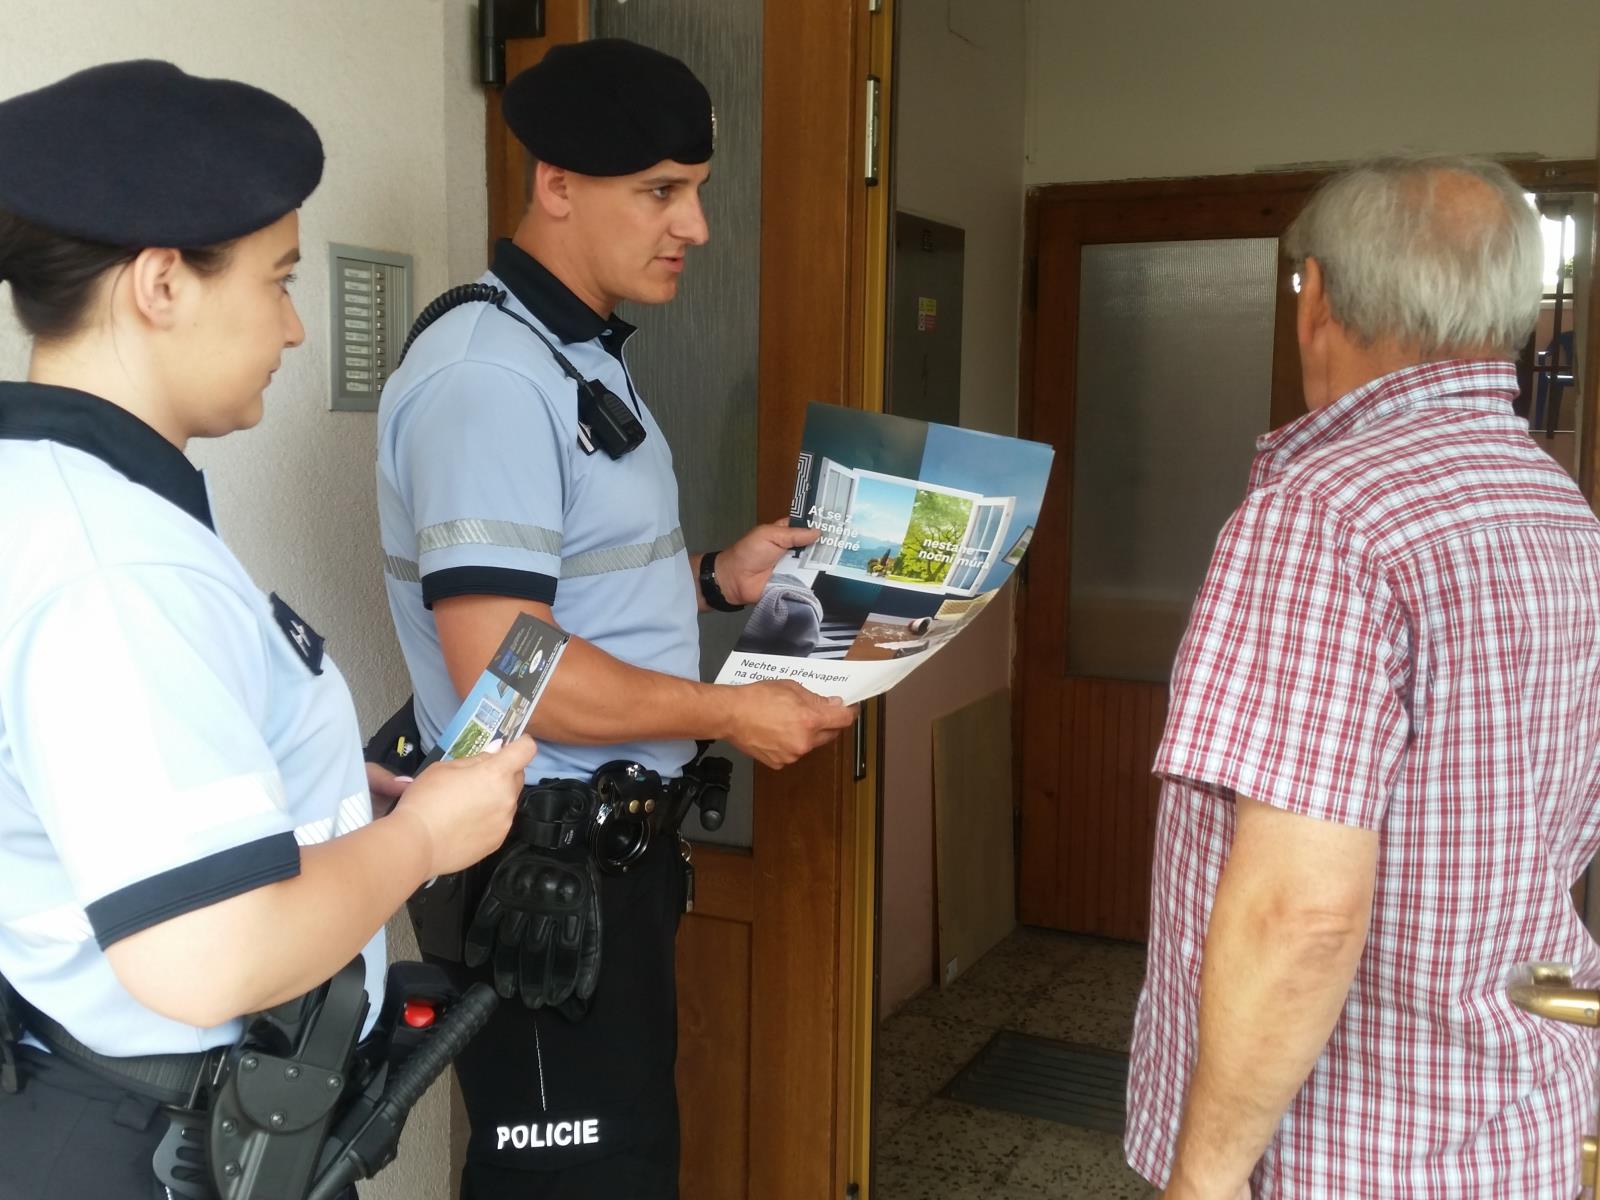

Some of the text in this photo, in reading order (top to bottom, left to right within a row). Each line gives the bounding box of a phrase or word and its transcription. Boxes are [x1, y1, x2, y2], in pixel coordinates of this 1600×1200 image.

[827, 510, 841, 521] se
[815, 535, 860, 551] volené
[923, 538, 974, 555] nestane
[734, 670, 747, 678] na
[740, 659, 850, 683] Nechte si překvapení
[497, 1119, 599, 1150] POLICIE
